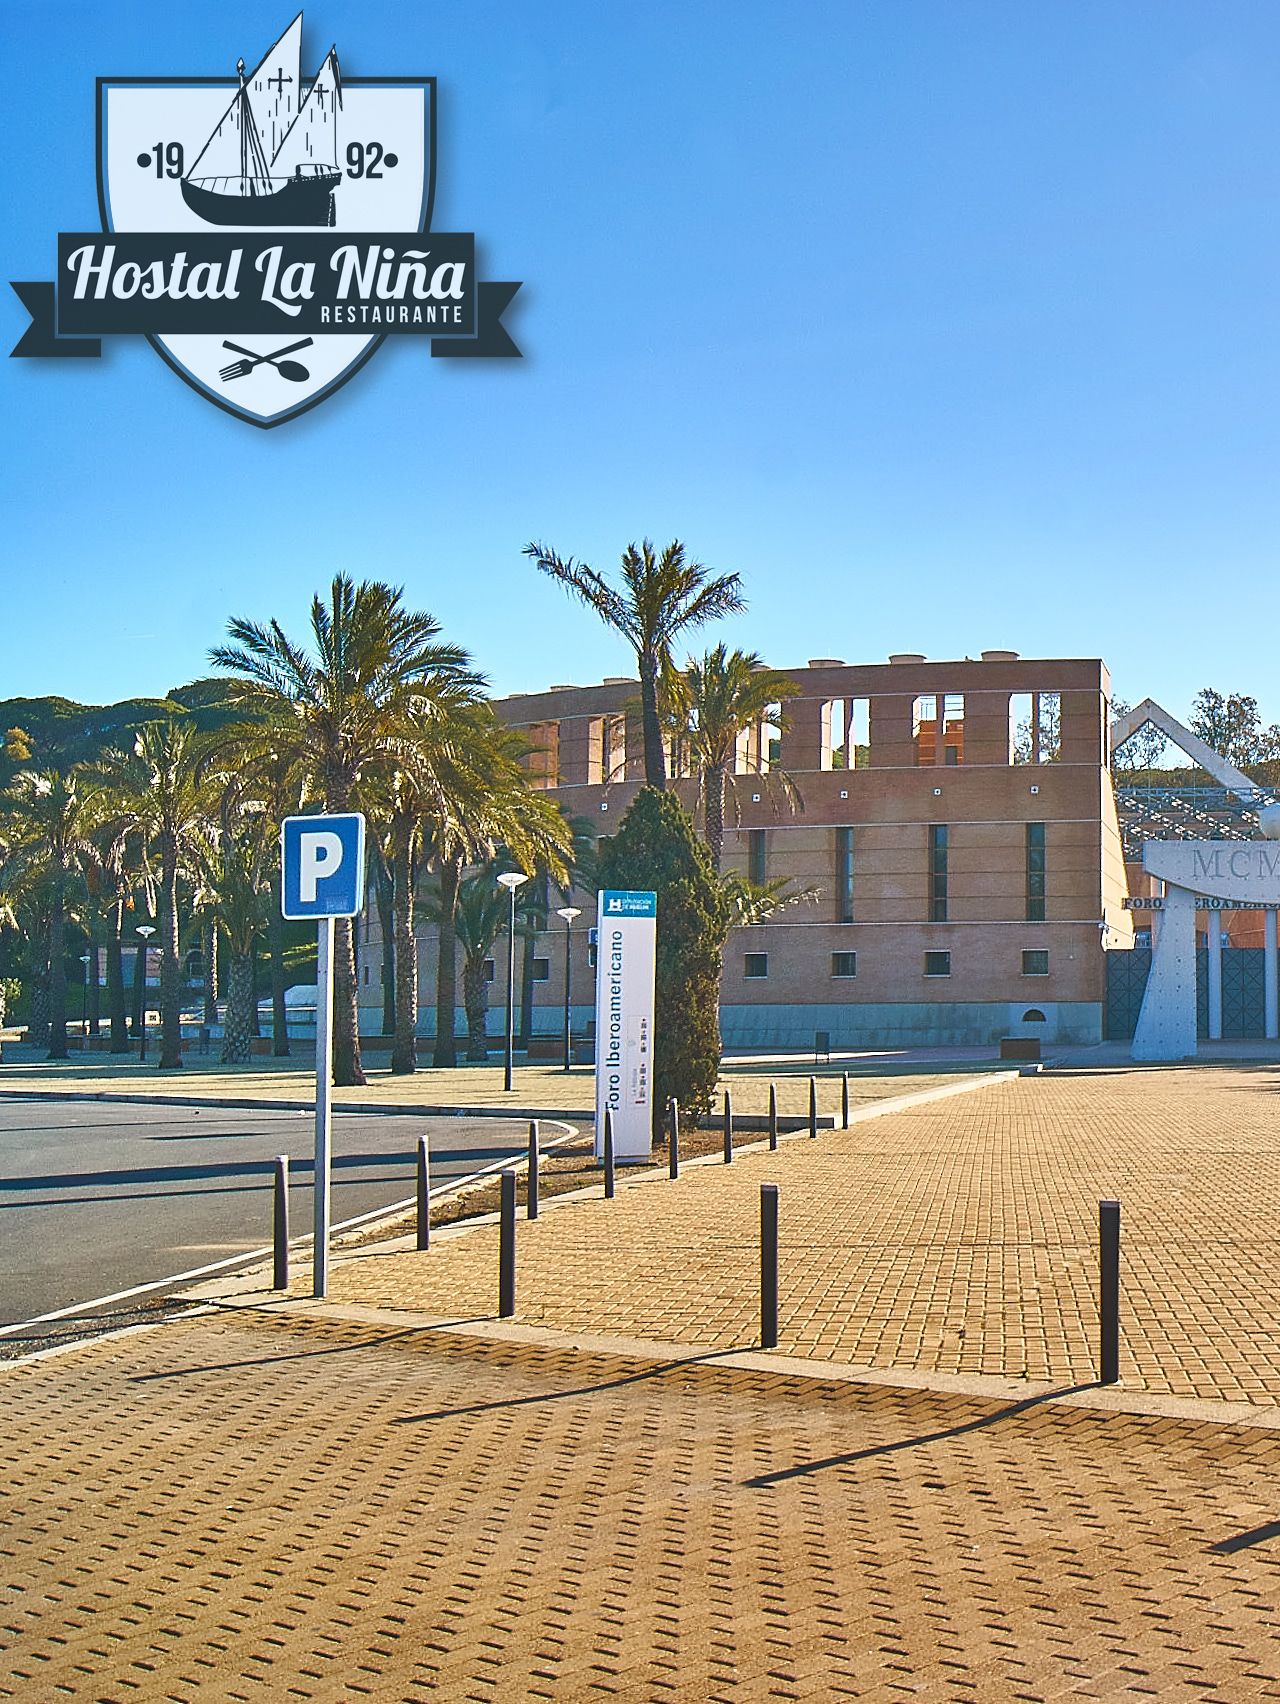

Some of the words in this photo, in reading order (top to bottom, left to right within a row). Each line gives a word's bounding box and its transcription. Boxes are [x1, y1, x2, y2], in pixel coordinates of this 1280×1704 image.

[300, 832, 343, 902] P
[1124, 897, 1162, 909] FORO
[606, 930, 623, 1067] Iberoamericano
[605, 1074, 620, 1110] Foro
